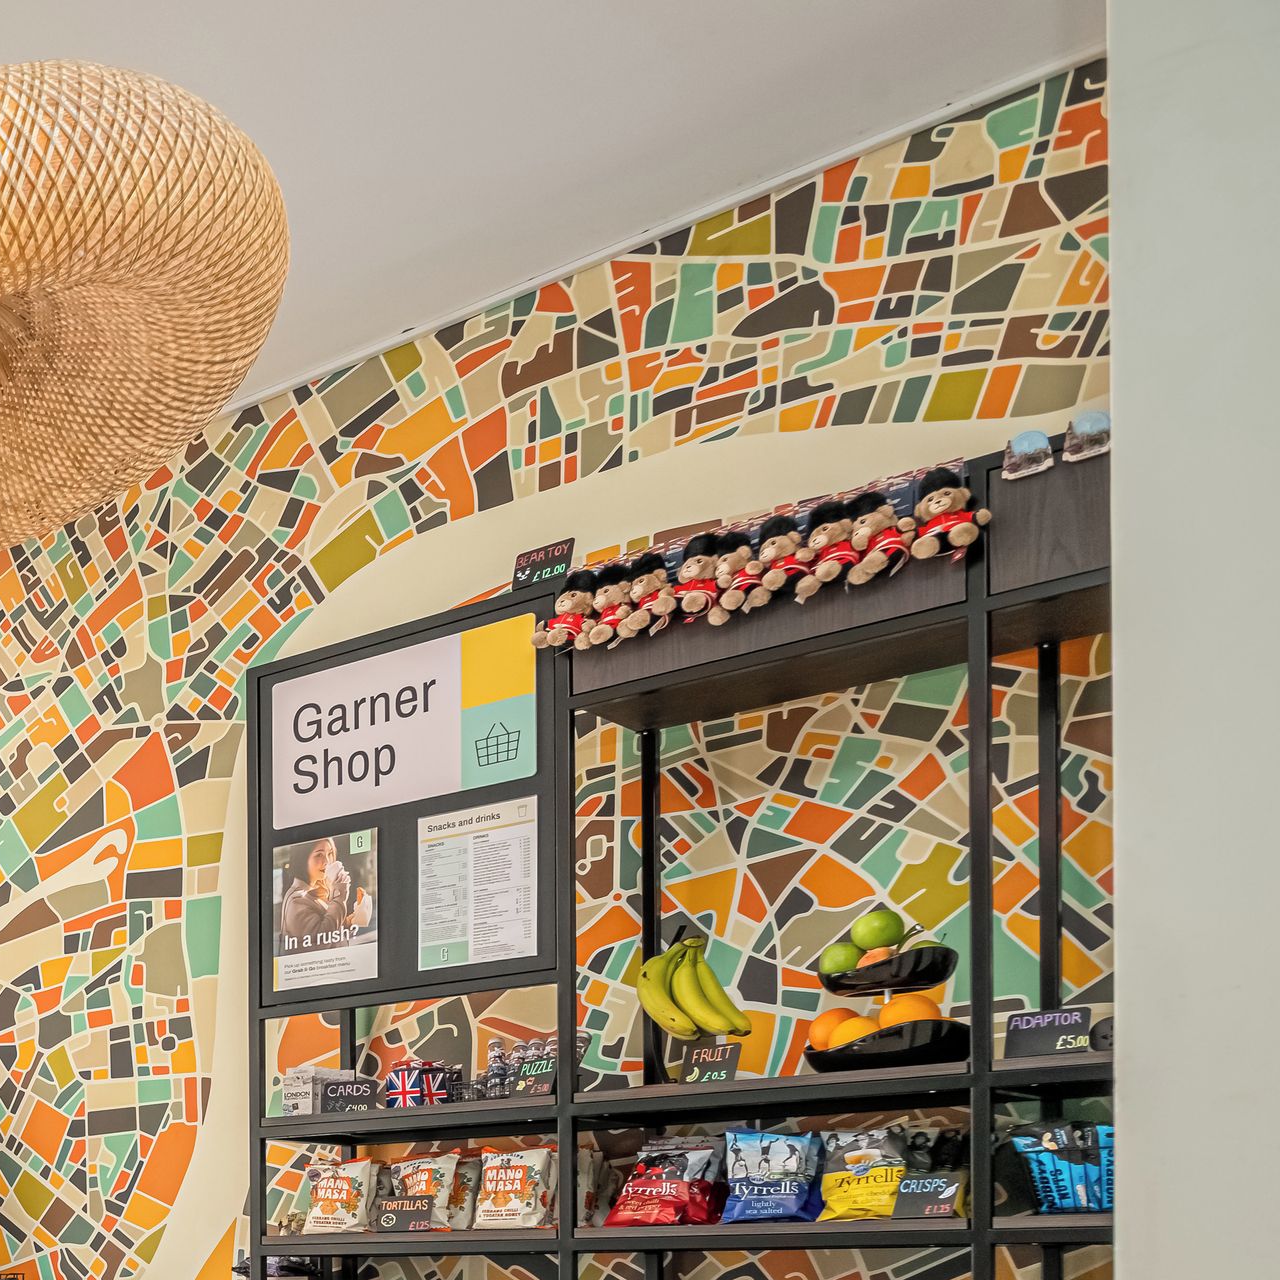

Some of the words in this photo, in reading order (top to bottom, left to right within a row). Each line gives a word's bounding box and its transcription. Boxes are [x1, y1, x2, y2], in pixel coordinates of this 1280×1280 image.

[516, 551, 545, 569] BEAR
[547, 542, 571, 558] TOY
[532, 563, 566, 583] £12.00
[293, 679, 436, 743] Garner
[293, 744, 396, 794] Shop
[427, 820, 456, 833] Snacks
[458, 817, 473, 827] and
[475, 812, 501, 824] drinks
[284, 935, 298, 950] In
[302, 934, 312, 948] a
[317, 924, 359, 946] rush?
[1009, 1011, 1082, 1030] ADAPTOR
[1055, 1034, 1089, 1050] £5.00
[692, 1045, 734, 1064] FRUIT
[520, 1059, 555, 1077] PUZZLE
[327, 1083, 371, 1097] CARDS
[486, 1168, 523, 1180] MANO
[318, 1177, 349, 1190] MANO
[486, 1180, 521, 1192] MASA
[900, 1178, 948, 1193] CRISPS
[1050, 1168, 1071, 1200] NUTS
[317, 1188, 347, 1200] MASA
[381, 1199, 429, 1211] TORTILLAS
